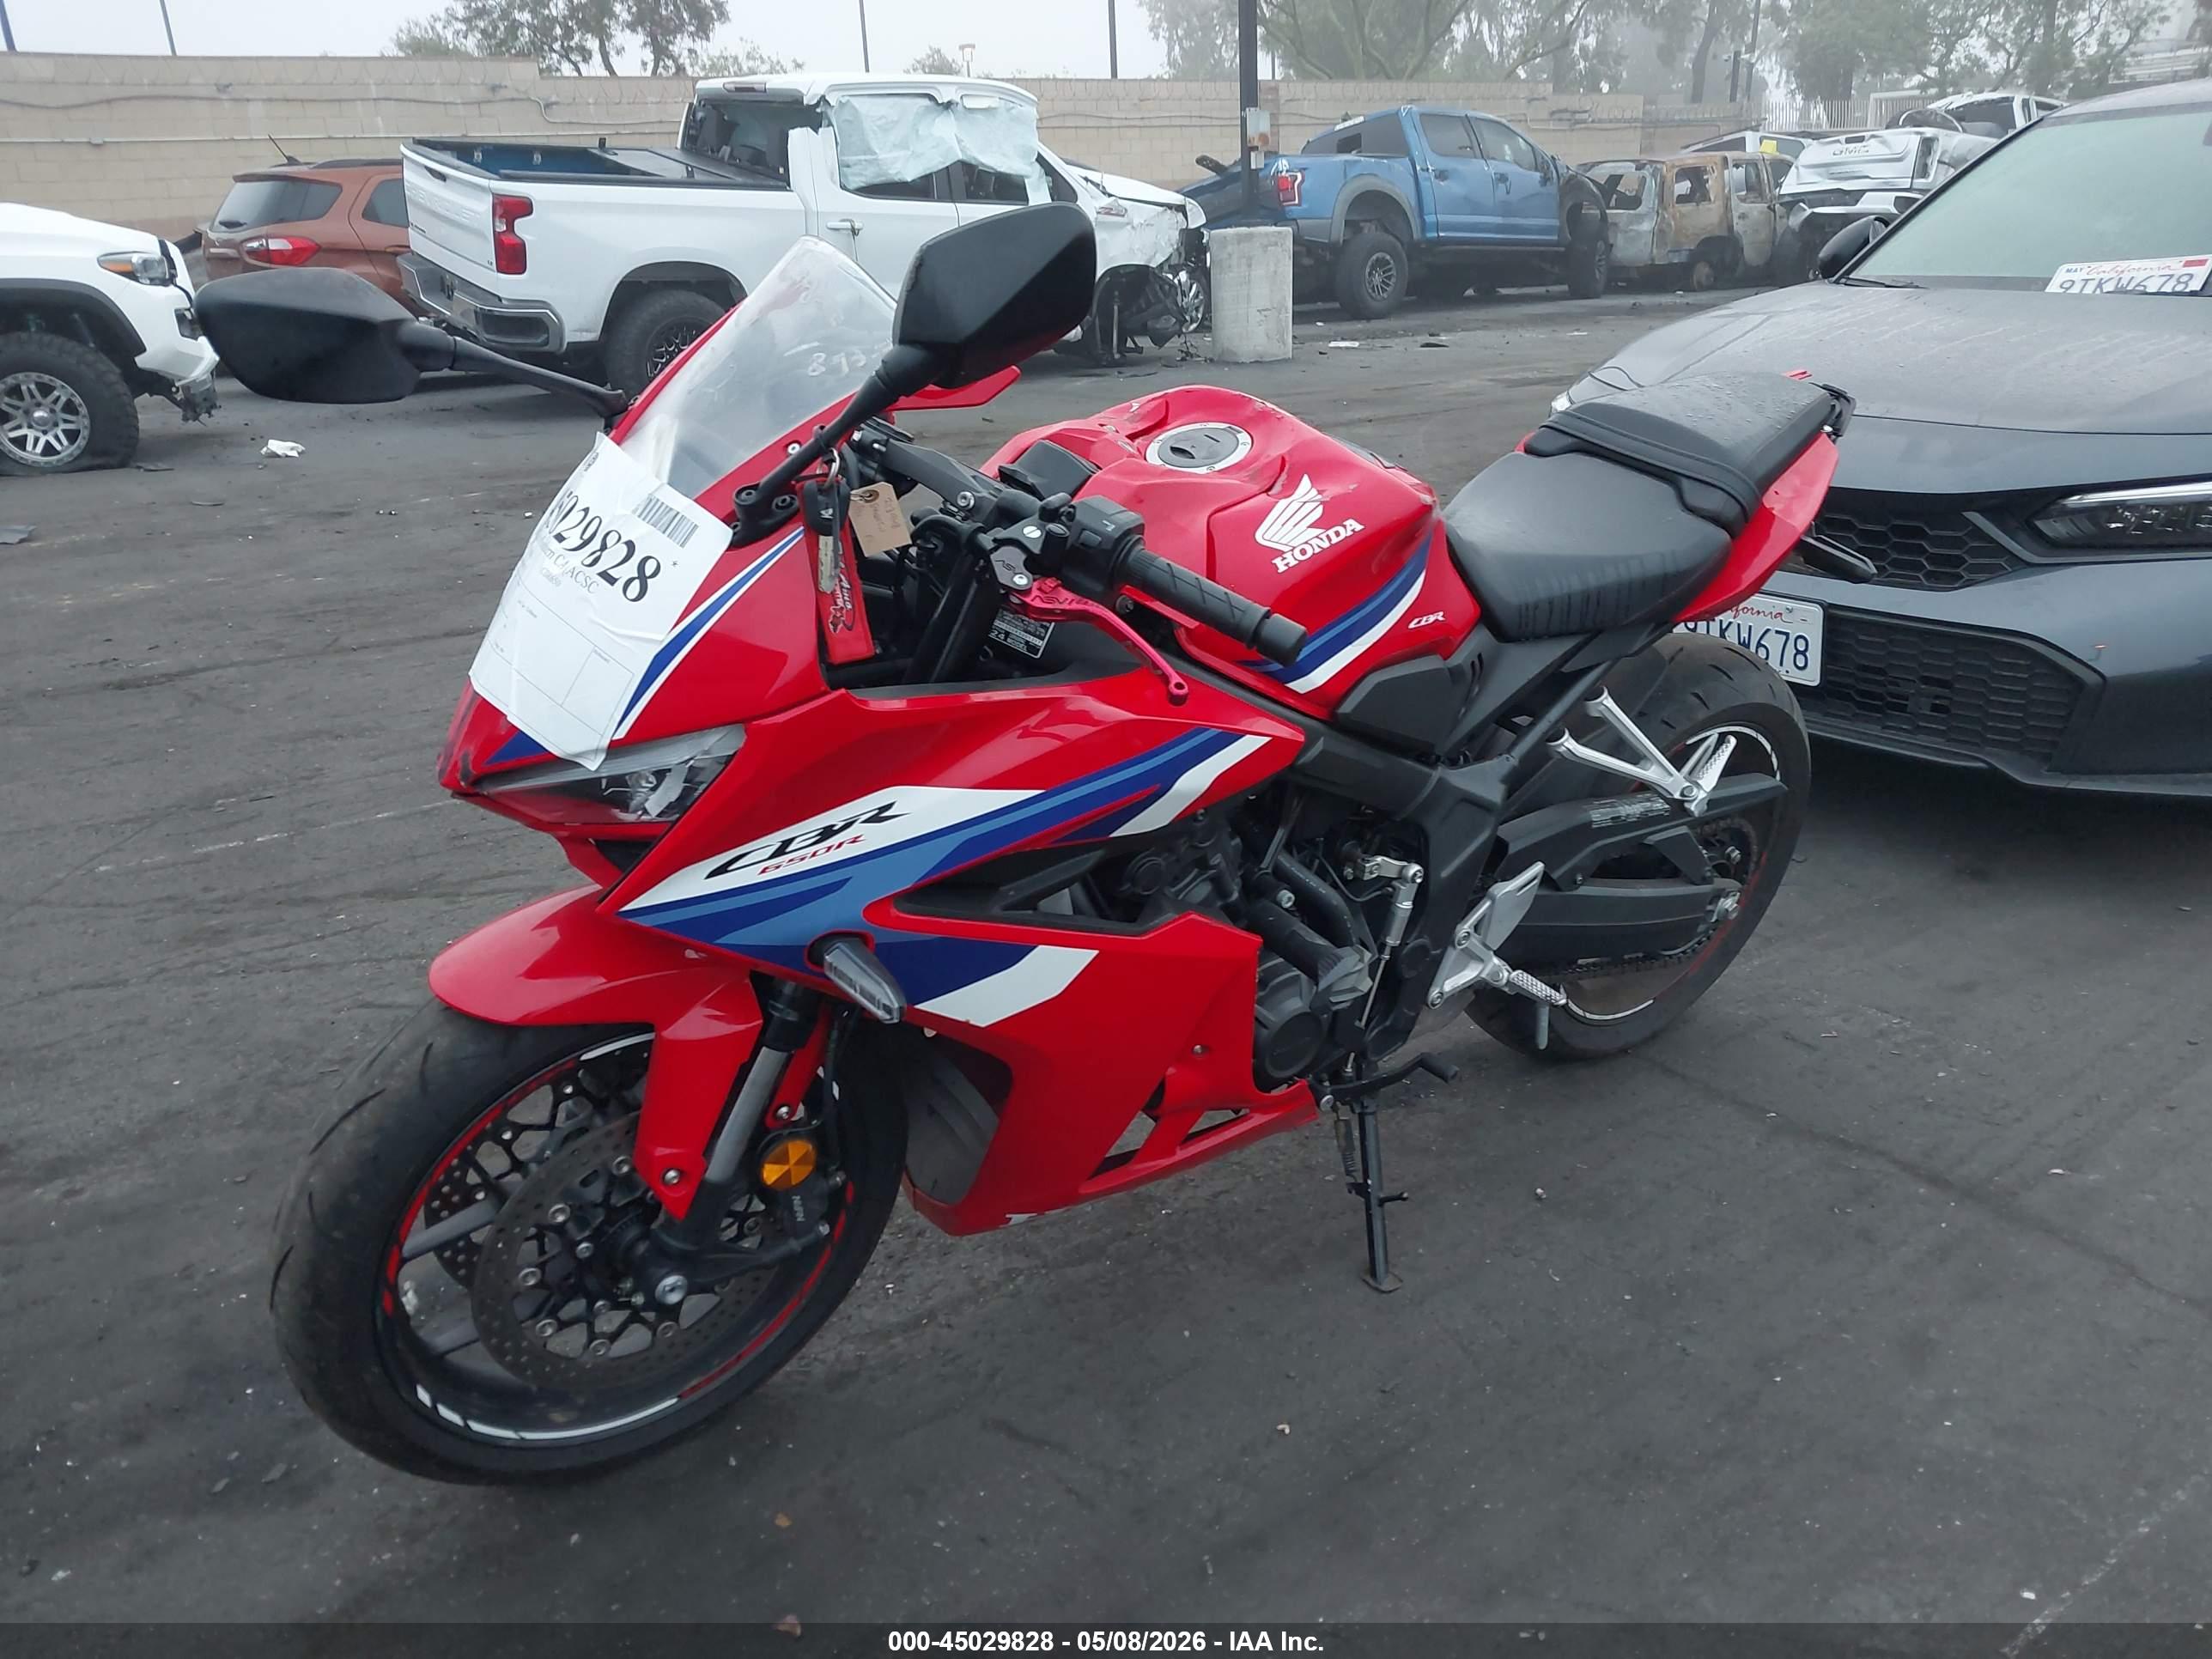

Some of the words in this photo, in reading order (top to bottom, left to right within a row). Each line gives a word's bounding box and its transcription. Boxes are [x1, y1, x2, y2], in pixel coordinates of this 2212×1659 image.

[2059, 273, 2195, 294] 9TKW678
[2086, 264, 2182, 276] California
[544, 489, 661, 603] 029828
[1272, 518, 1365, 574] HONDA
[1407, 611, 1446, 629] CBR
[703, 800, 914, 880] CBR
[757, 834, 866, 876] 650R
